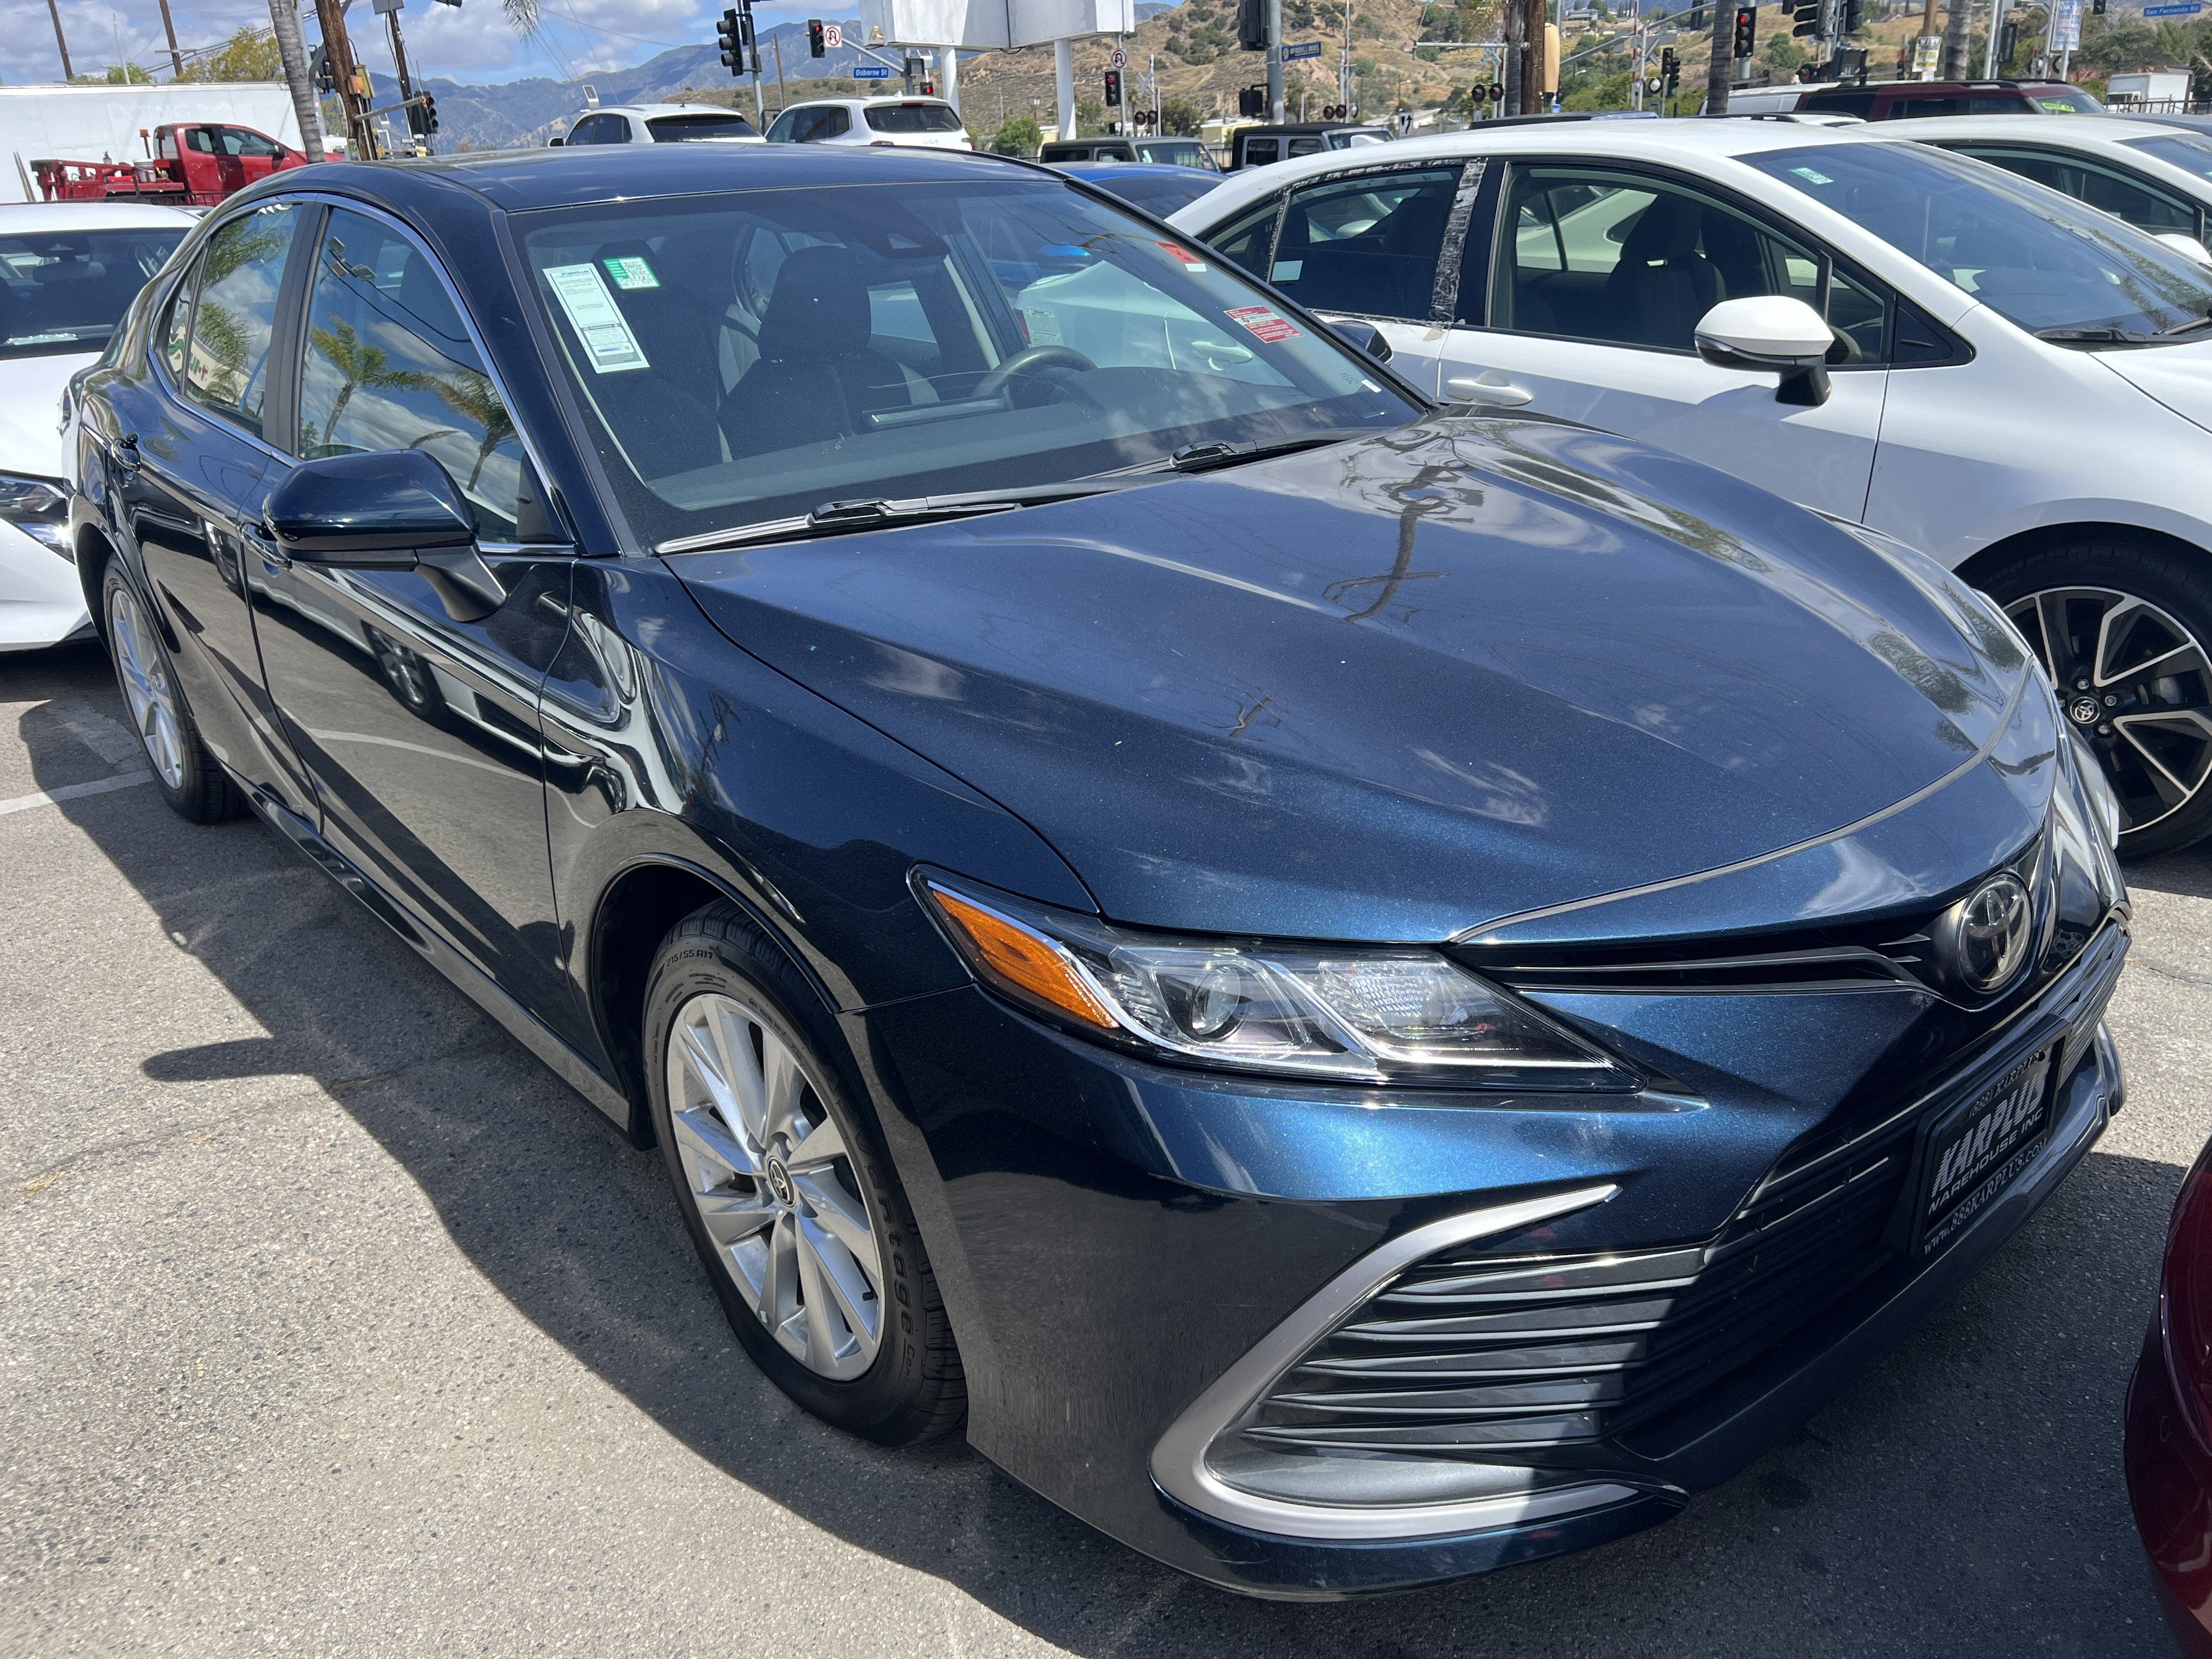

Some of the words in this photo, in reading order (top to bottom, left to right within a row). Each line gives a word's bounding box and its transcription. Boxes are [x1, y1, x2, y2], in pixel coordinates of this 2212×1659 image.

[666, 949, 695, 967] 215/55
[696, 950, 714, 960] R17
[1969, 1089, 1993, 1118] (888)
[1931, 1061, 2051, 1198] KARPLUS
[2021, 1107, 2044, 1135] INC
